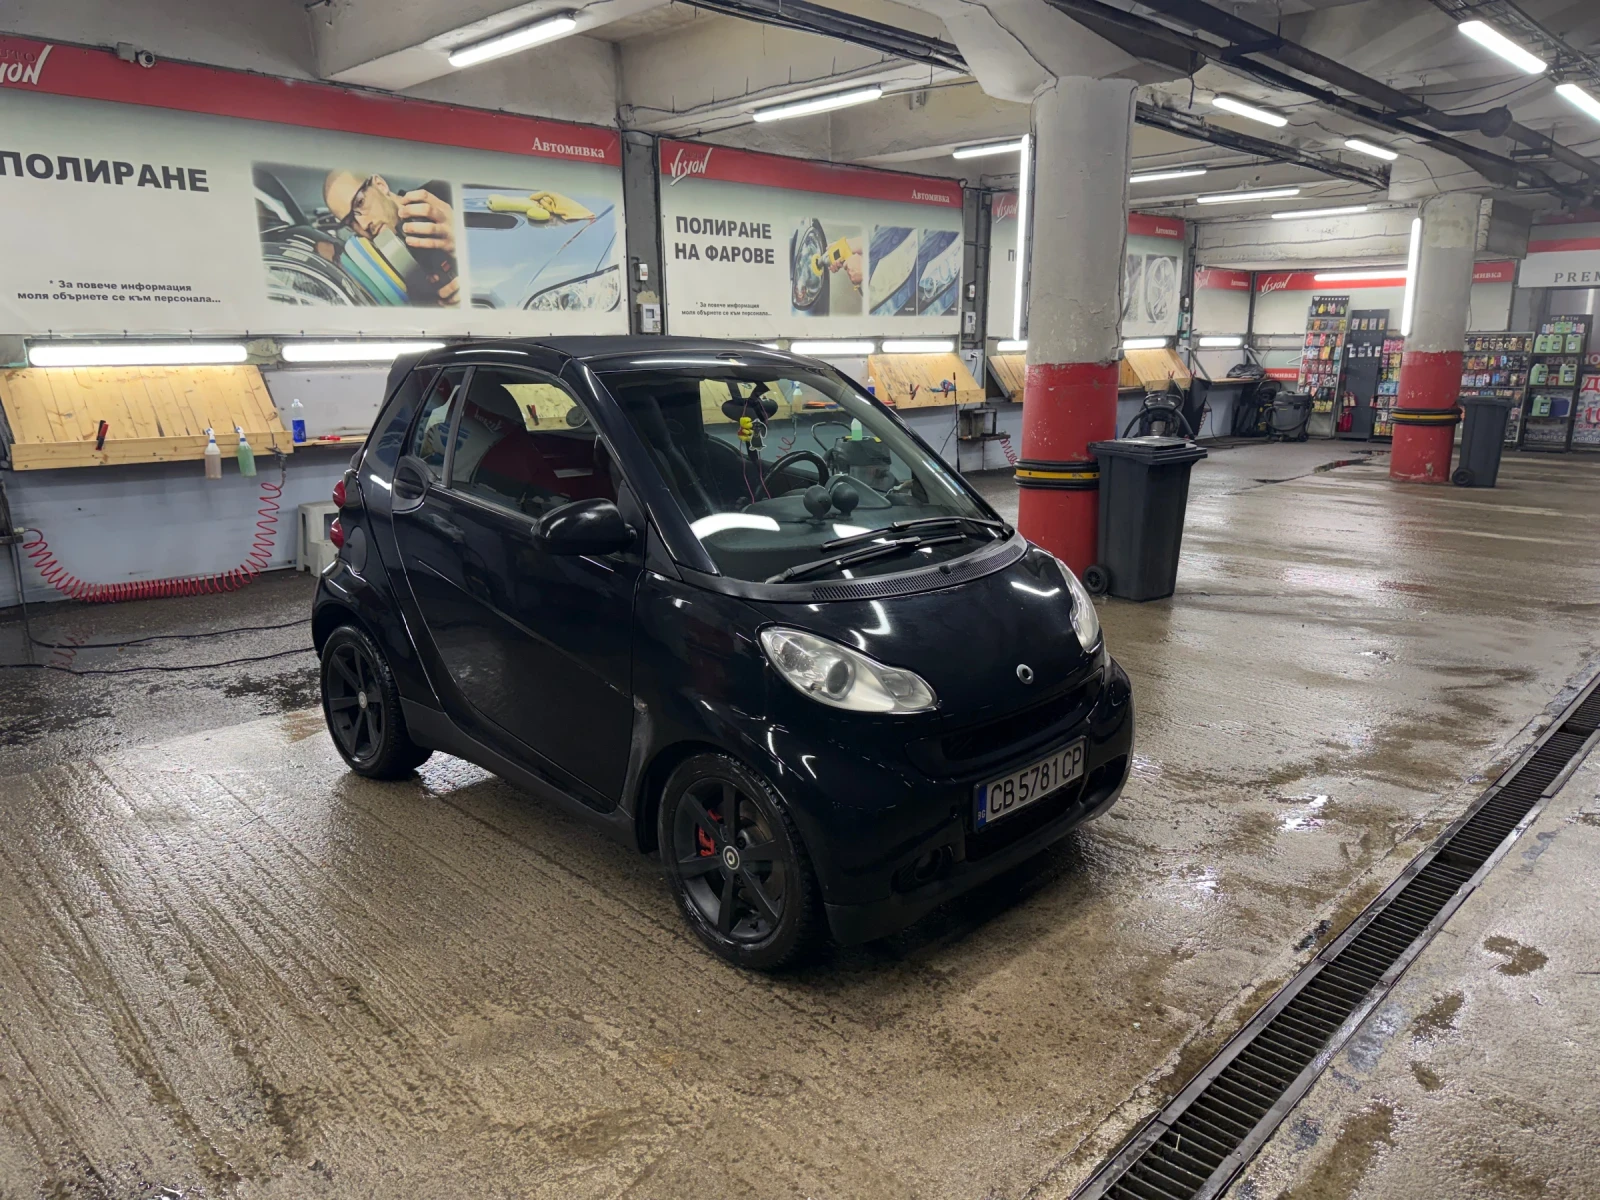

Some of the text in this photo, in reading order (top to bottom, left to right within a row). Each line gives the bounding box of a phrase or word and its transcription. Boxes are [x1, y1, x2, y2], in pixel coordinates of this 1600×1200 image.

[531, 137, 605, 158] Автомивка
[0, 150, 209, 192] ПОЛИРАНЕ
[670, 147, 713, 187] VISION
[911, 189, 950, 203] Автомивка
[676, 216, 772, 239] ПОЛИРАНЕ
[675, 242, 775, 264] НА ФАРОВЕ
[17, 292, 49, 300] моля
[52, 292, 109, 302] обърнете
[112, 293, 125, 301] се
[128, 294, 151, 302] към
[58, 280, 192, 292] За повече информация
[990, 746, 1082, 814] CB 5781 CP
